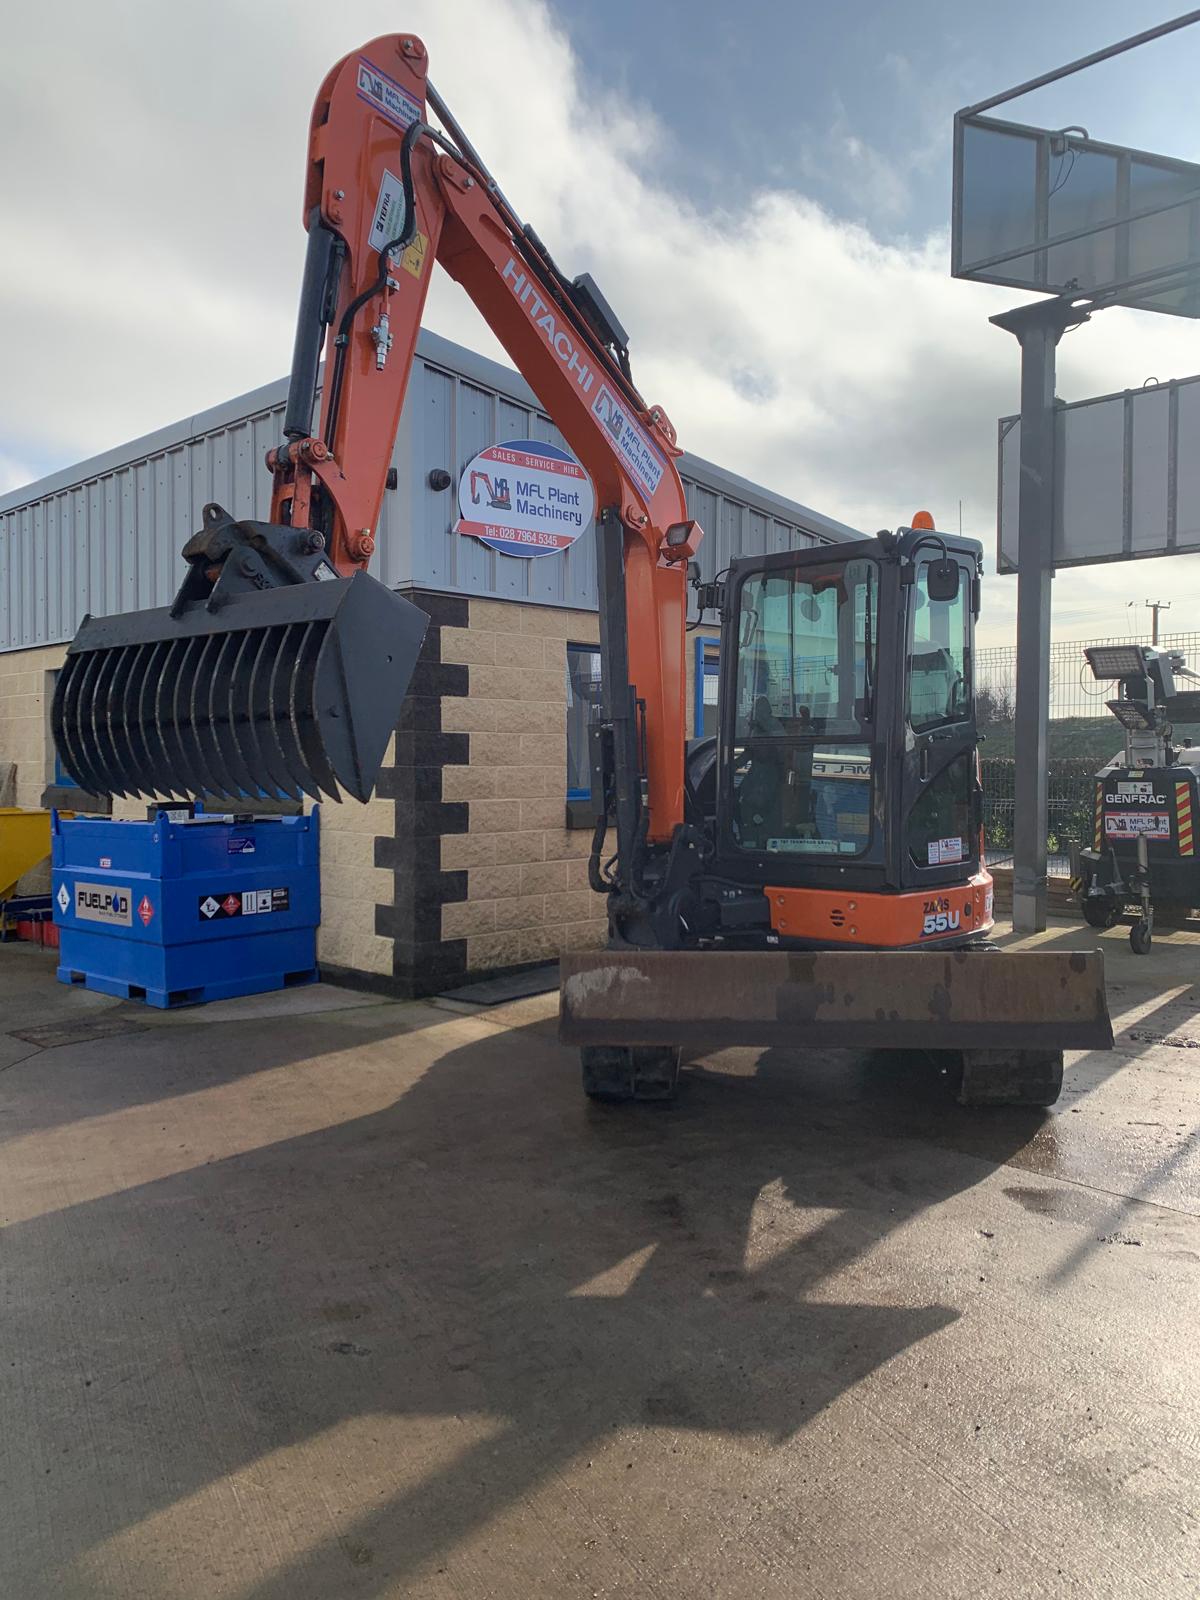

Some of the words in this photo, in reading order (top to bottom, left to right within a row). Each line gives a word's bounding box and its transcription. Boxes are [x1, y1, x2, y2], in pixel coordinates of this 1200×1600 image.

[502, 257, 594, 393] HITACHI
[492, 450, 516, 463] SALES
[525, 457, 555, 471] SERVICE
[563, 465, 579, 476] HIRE
[620, 436, 656, 492] Machinery
[624, 426, 644, 453] MFL
[641, 444, 661, 478] Plant
[516, 480, 544, 500] MFL
[548, 487, 580, 506] Plant
[516, 499, 582, 526] Machinery
[484, 526, 499, 537] Tel:
[499, 527, 515, 540] 028
[517, 529, 537, 543] 7964
[538, 532, 558, 546] 5345
[923, 910, 960, 934] 55U
